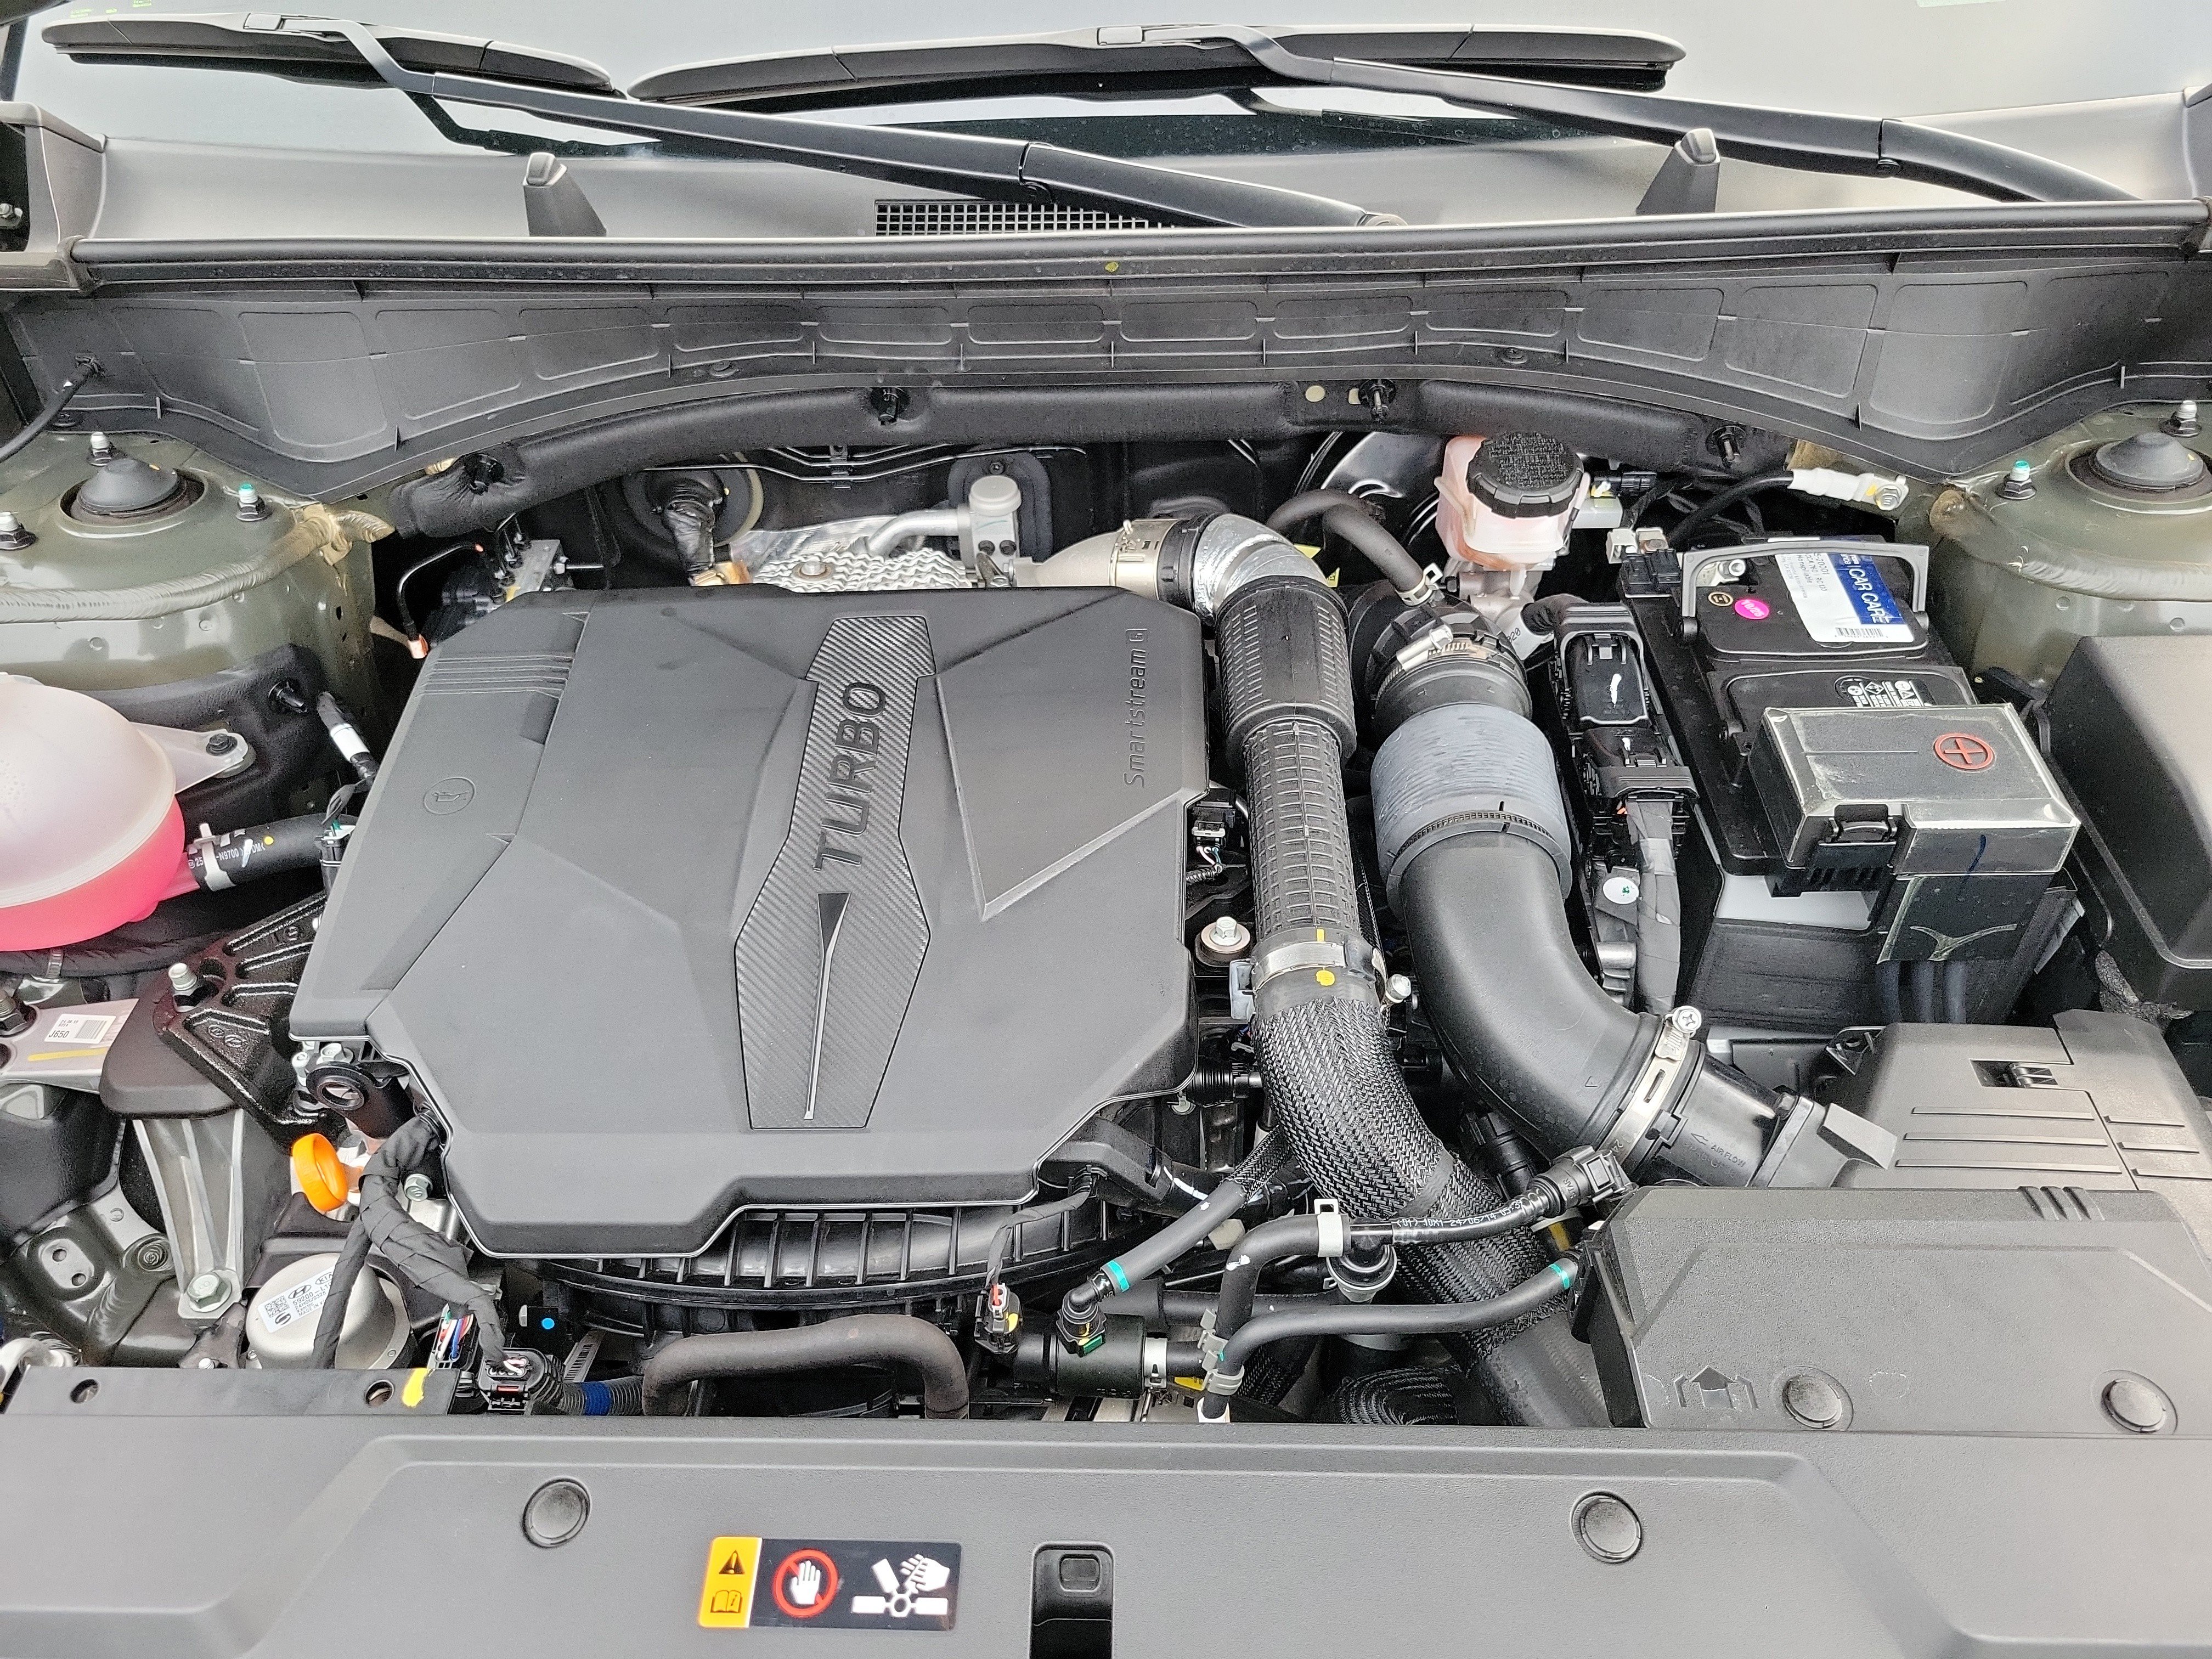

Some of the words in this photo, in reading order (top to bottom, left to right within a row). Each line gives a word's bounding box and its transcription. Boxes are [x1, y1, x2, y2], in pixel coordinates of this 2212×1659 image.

[1849, 568, 1873, 591] CAR
[1861, 592, 1890, 624] CARE
[1124, 648, 1147, 788] Smartstream
[813, 682, 887, 872] TURBO
[48, 1030, 70, 1038] J650
[1563, 1178, 1577, 1200] STAR
